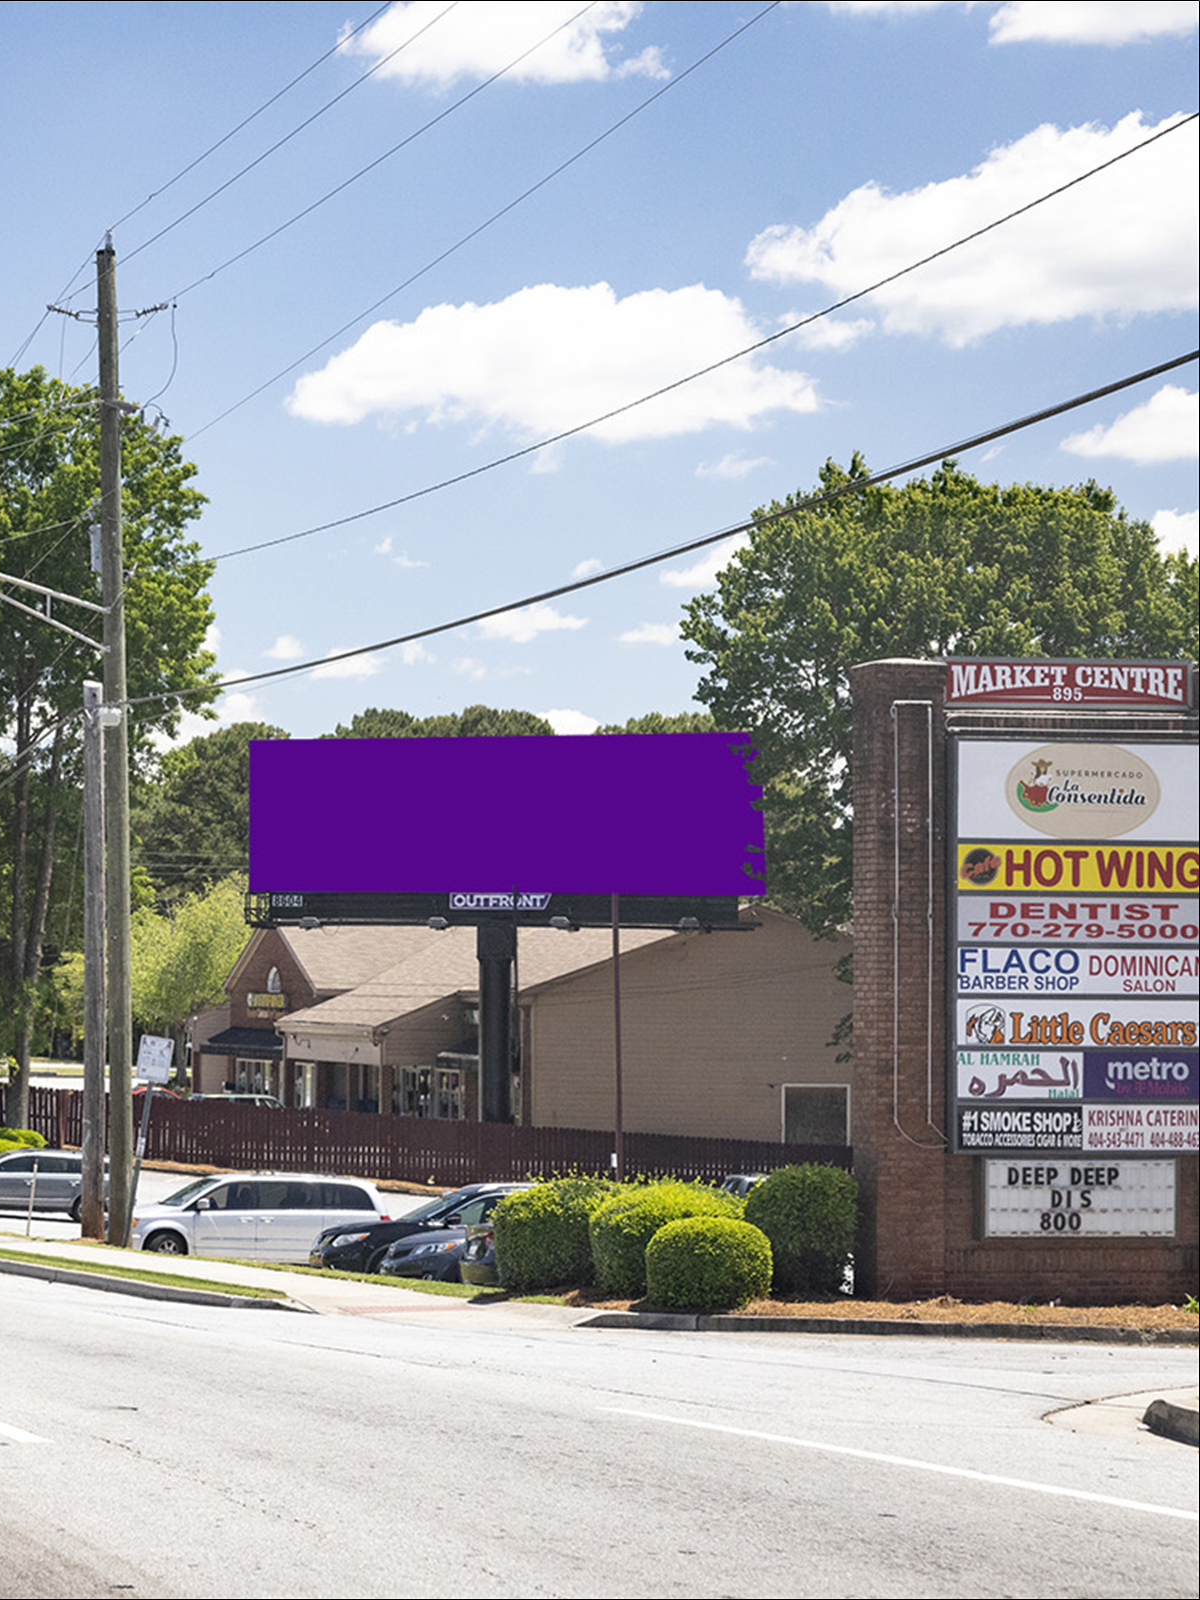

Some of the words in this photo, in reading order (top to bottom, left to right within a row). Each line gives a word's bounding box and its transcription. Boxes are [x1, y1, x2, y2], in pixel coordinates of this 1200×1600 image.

[951, 665, 1067, 698] MARKET
[1075, 666, 1183, 702] CENTRE
[1052, 687, 1083, 701] 895
[1055, 769, 1143, 779] SUPERMERCADO
[1063, 779, 1079, 792] La
[1048, 785, 1146, 806] Consentida
[1005, 849, 1089, 888] HOT
[453, 894, 545, 907] OUTFRONT
[989, 902, 1179, 921] DENTIST
[967, 922, 1199, 940] 770-279-5000
[959, 949, 1080, 974] FLACO
[1088, 954, 1199, 978] DOMINICA
[959, 975, 1029, 990] BARBER
[1034, 976, 1080, 991] SHOP
[1122, 979, 1176, 992] SALON
[1009, 1012, 1085, 1045] Little
[1090, 1013, 1198, 1046] Caesars
[957, 1052, 975, 1066] AL
[980, 1052, 1041, 1066] HAMRAH
[1106, 1057, 1190, 1081] metro
[1048, 1089, 1080, 1099] Halal
[962, 1111, 979, 1131] #1
[980, 1111, 1031, 1132] SMOKE
[1033, 1112, 1072, 1133] SHOP
[1088, 1109, 1143, 1127] KRISHNA
[962, 1132, 993, 1146] TOBACCO
[1088, 1131, 1145, 1149] 404-543-4471
[1007, 1167, 1058, 1186] DEEP
[1070, 1167, 1119, 1186] DEEP
[1040, 1212, 1082, 1231] 800
